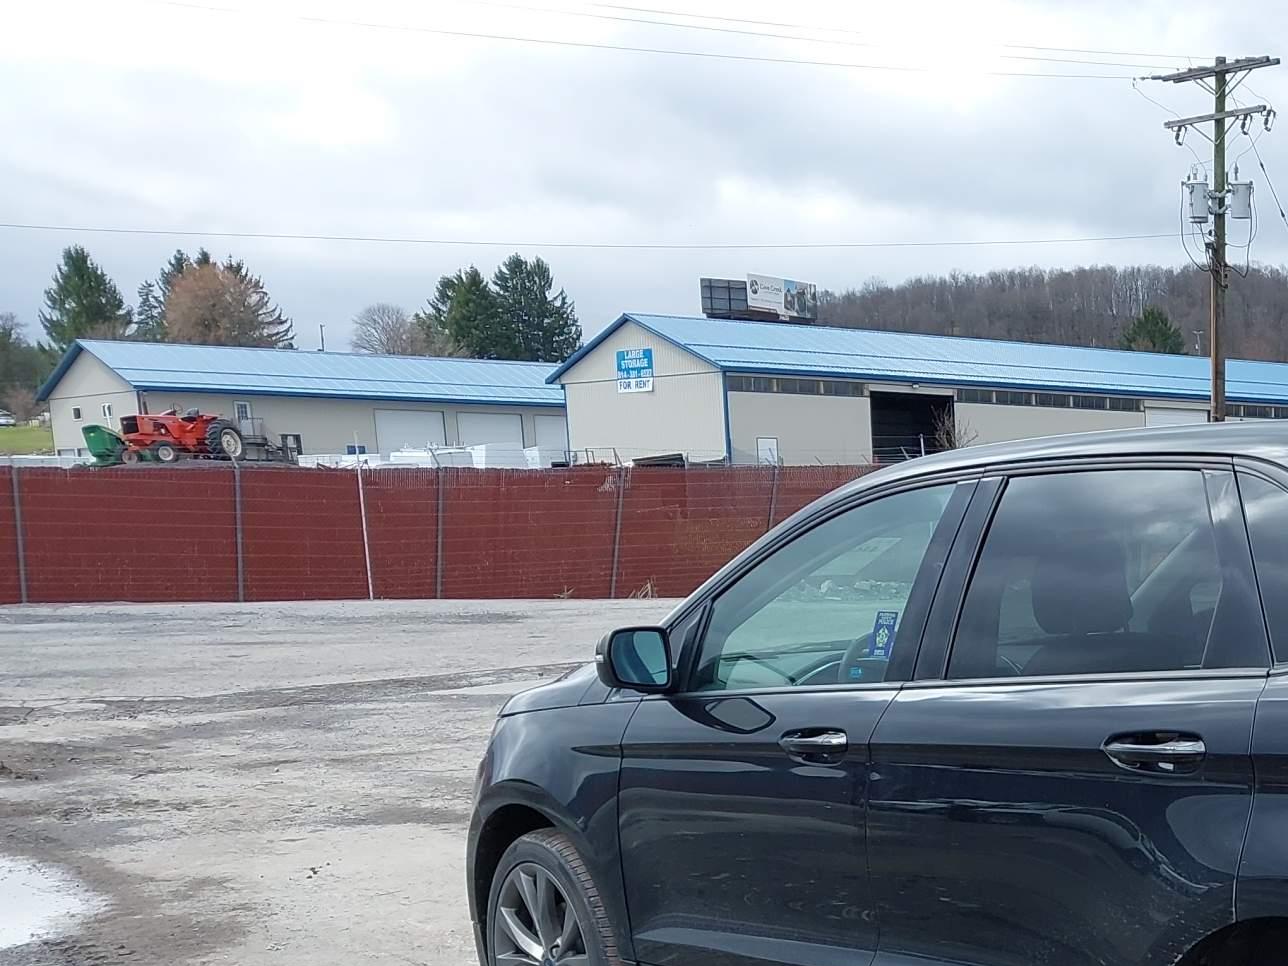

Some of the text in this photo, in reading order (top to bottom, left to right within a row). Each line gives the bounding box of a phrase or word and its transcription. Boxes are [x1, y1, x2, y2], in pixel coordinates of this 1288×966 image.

[624, 350, 644, 360] LARGE
[620, 359, 648, 369] STORAGE
[619, 379, 650, 390] FOR RENT
